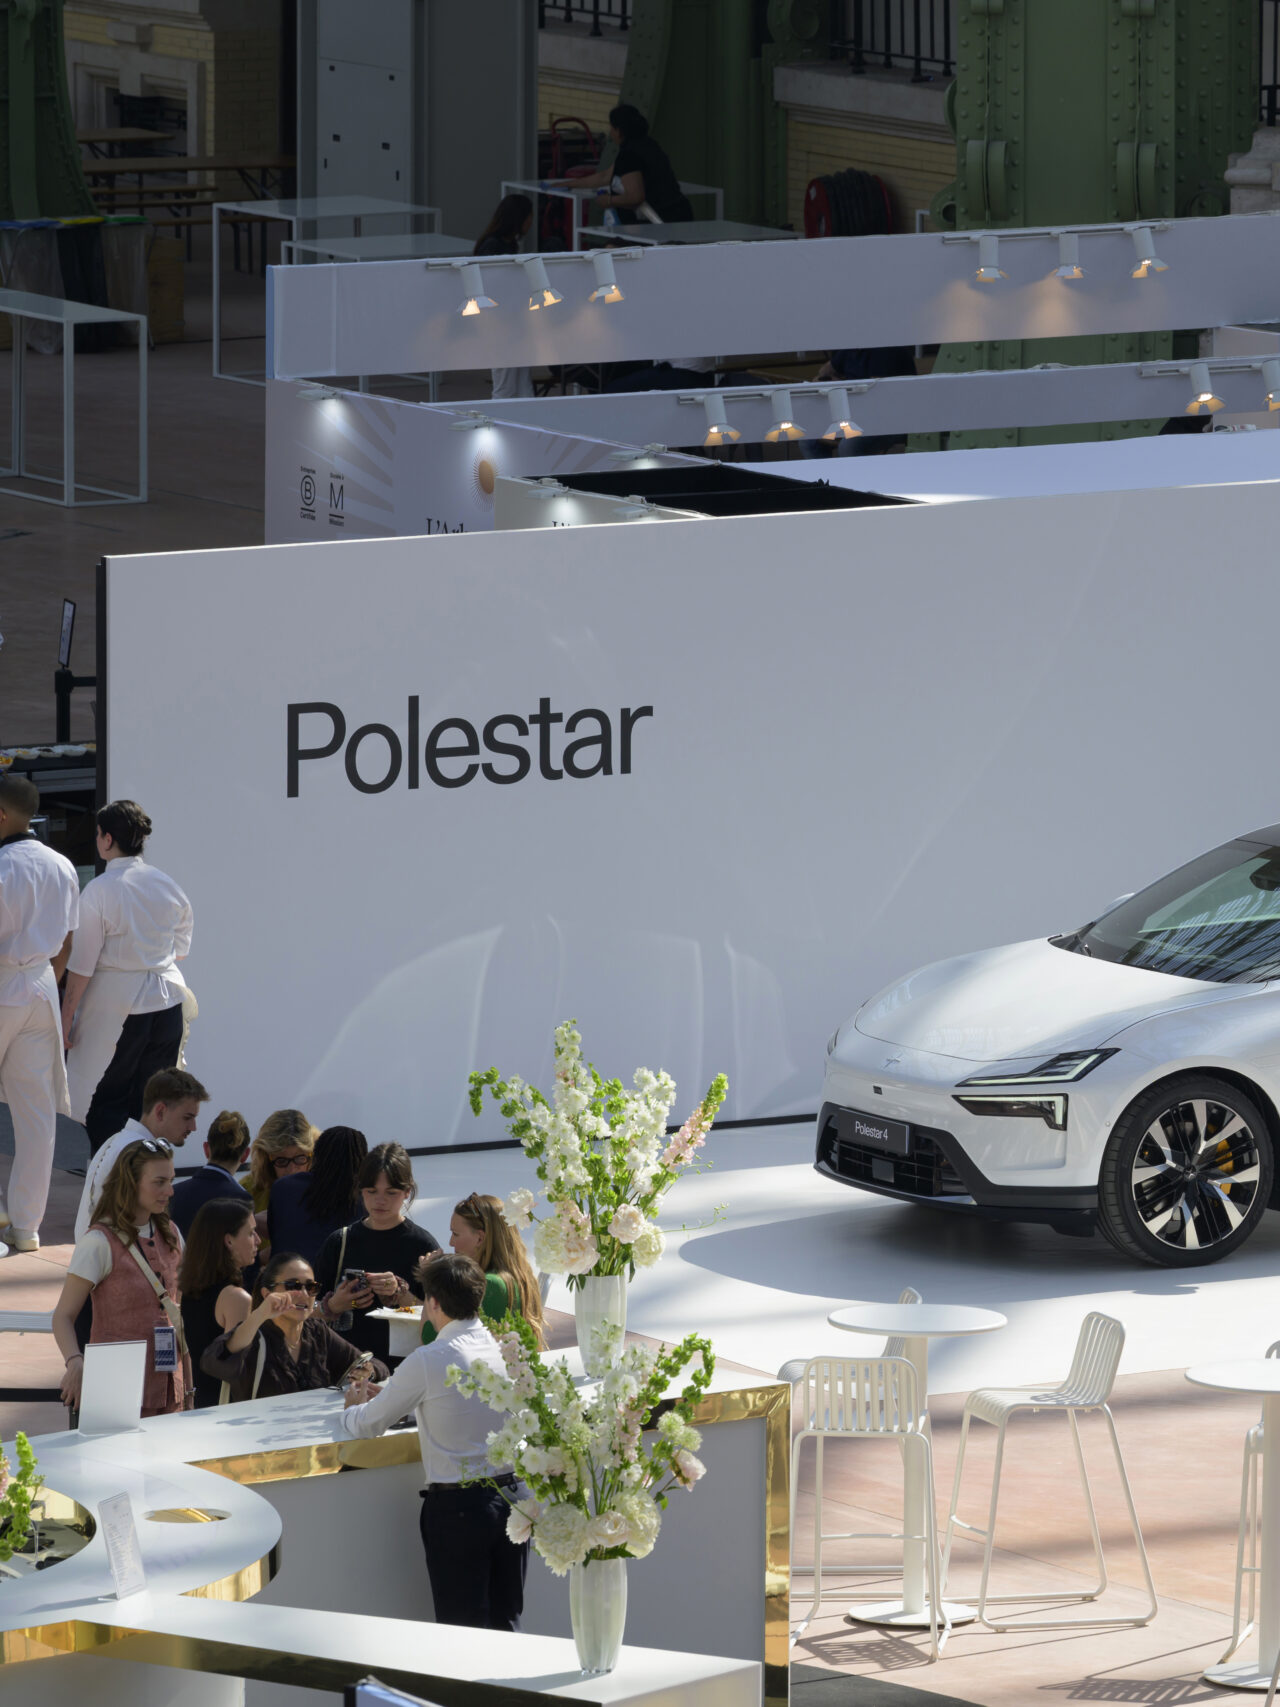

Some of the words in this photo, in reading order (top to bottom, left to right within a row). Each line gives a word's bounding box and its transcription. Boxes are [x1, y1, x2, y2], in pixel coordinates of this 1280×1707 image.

[329, 482, 344, 511] M
[286, 695, 654, 799] Polestar
[855, 1121, 882, 1139] Polestar
[883, 1128, 888, 1140] 4
